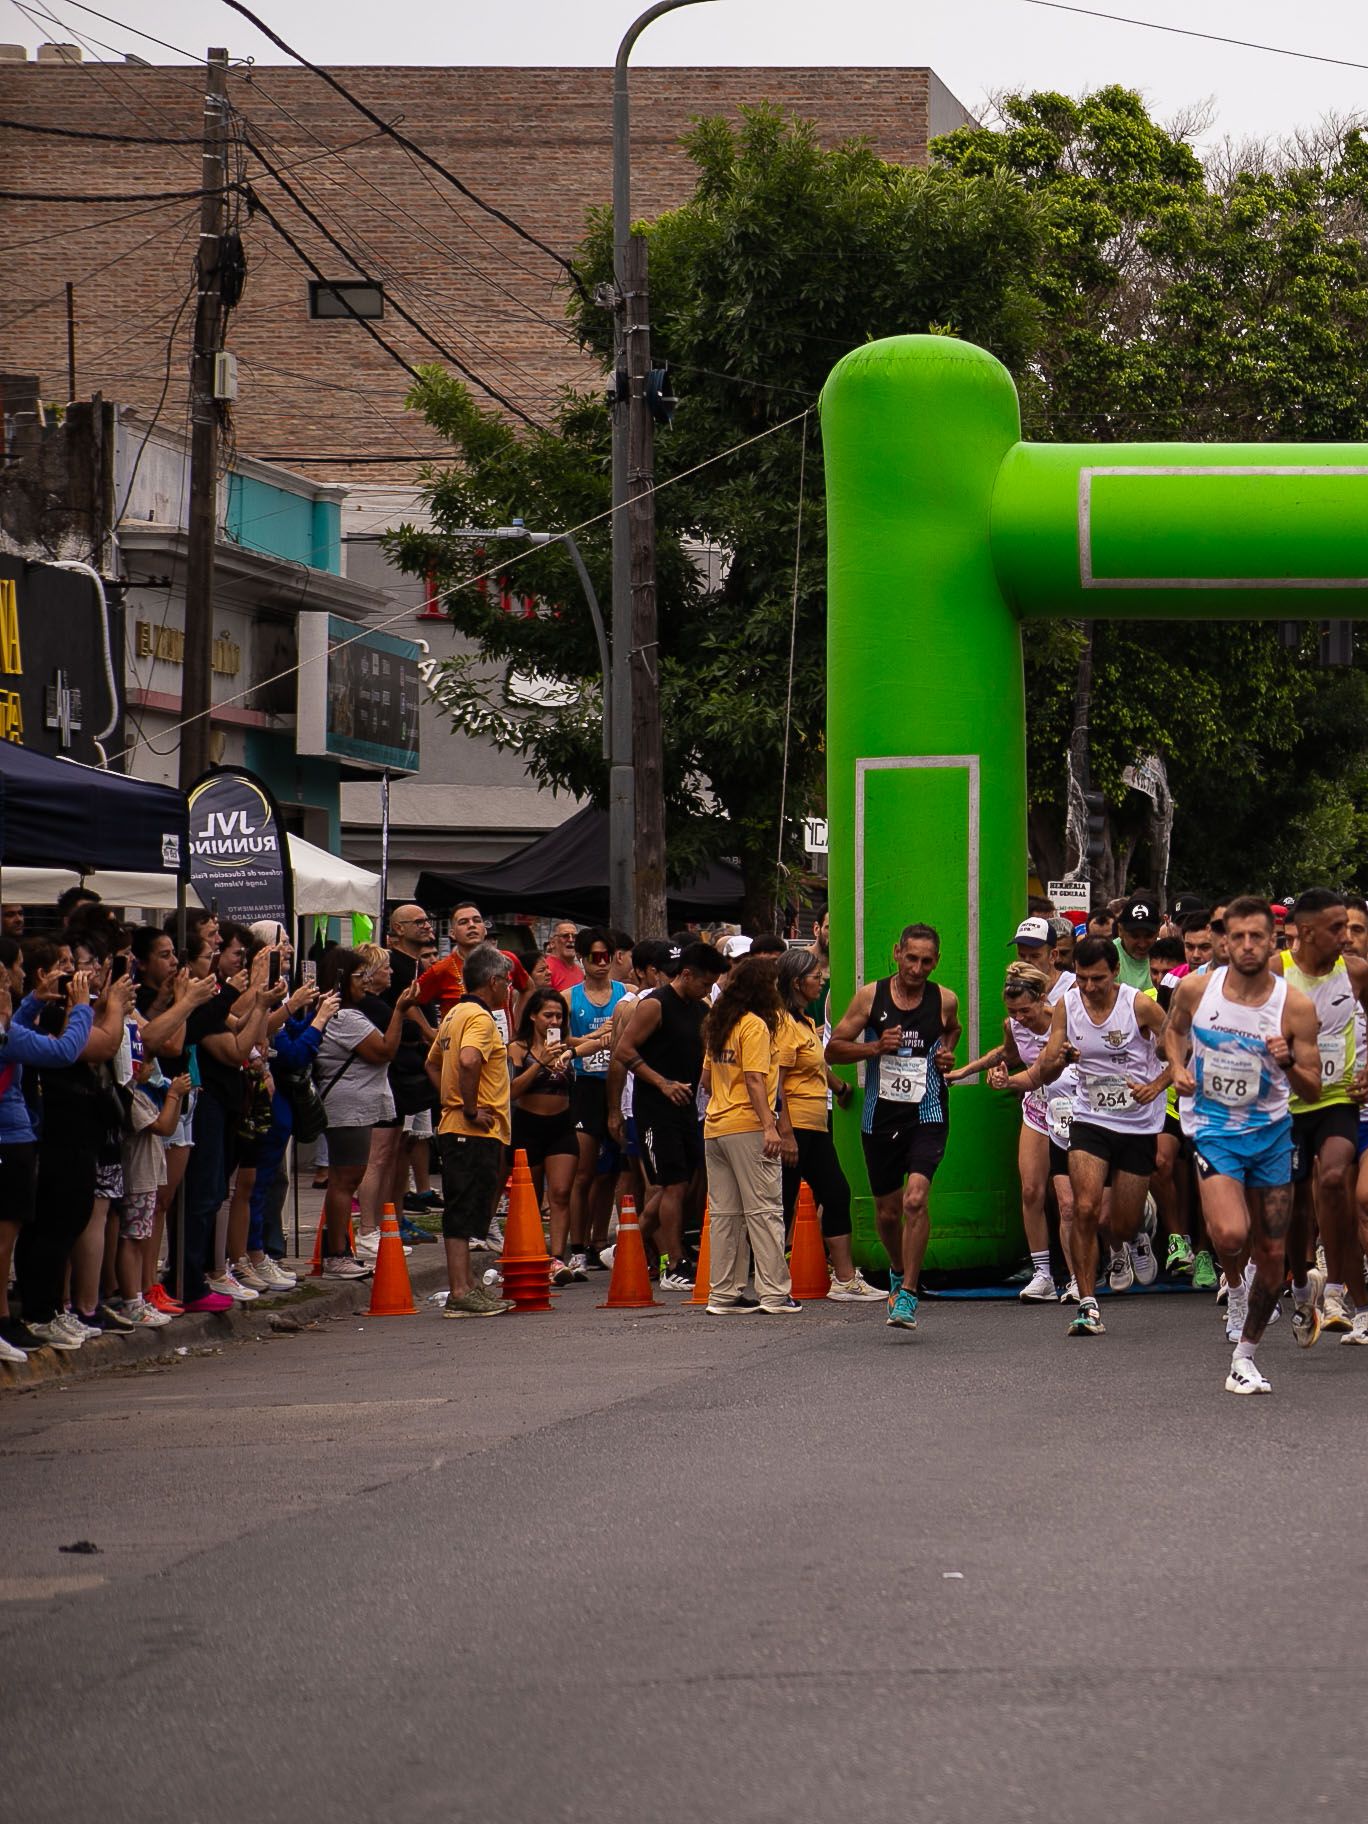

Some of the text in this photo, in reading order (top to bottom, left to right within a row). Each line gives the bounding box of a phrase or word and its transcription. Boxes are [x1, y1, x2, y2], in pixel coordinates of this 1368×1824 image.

[902, 1030, 919, 1040] SARIO
[1210, 1024, 1262, 1041] ARGENTINA
[1320, 1060, 1335, 1077] 0
[891, 1077, 912, 1094] 49
[1212, 1075, 1247, 1097] 678
[1096, 1091, 1127, 1107] 254
